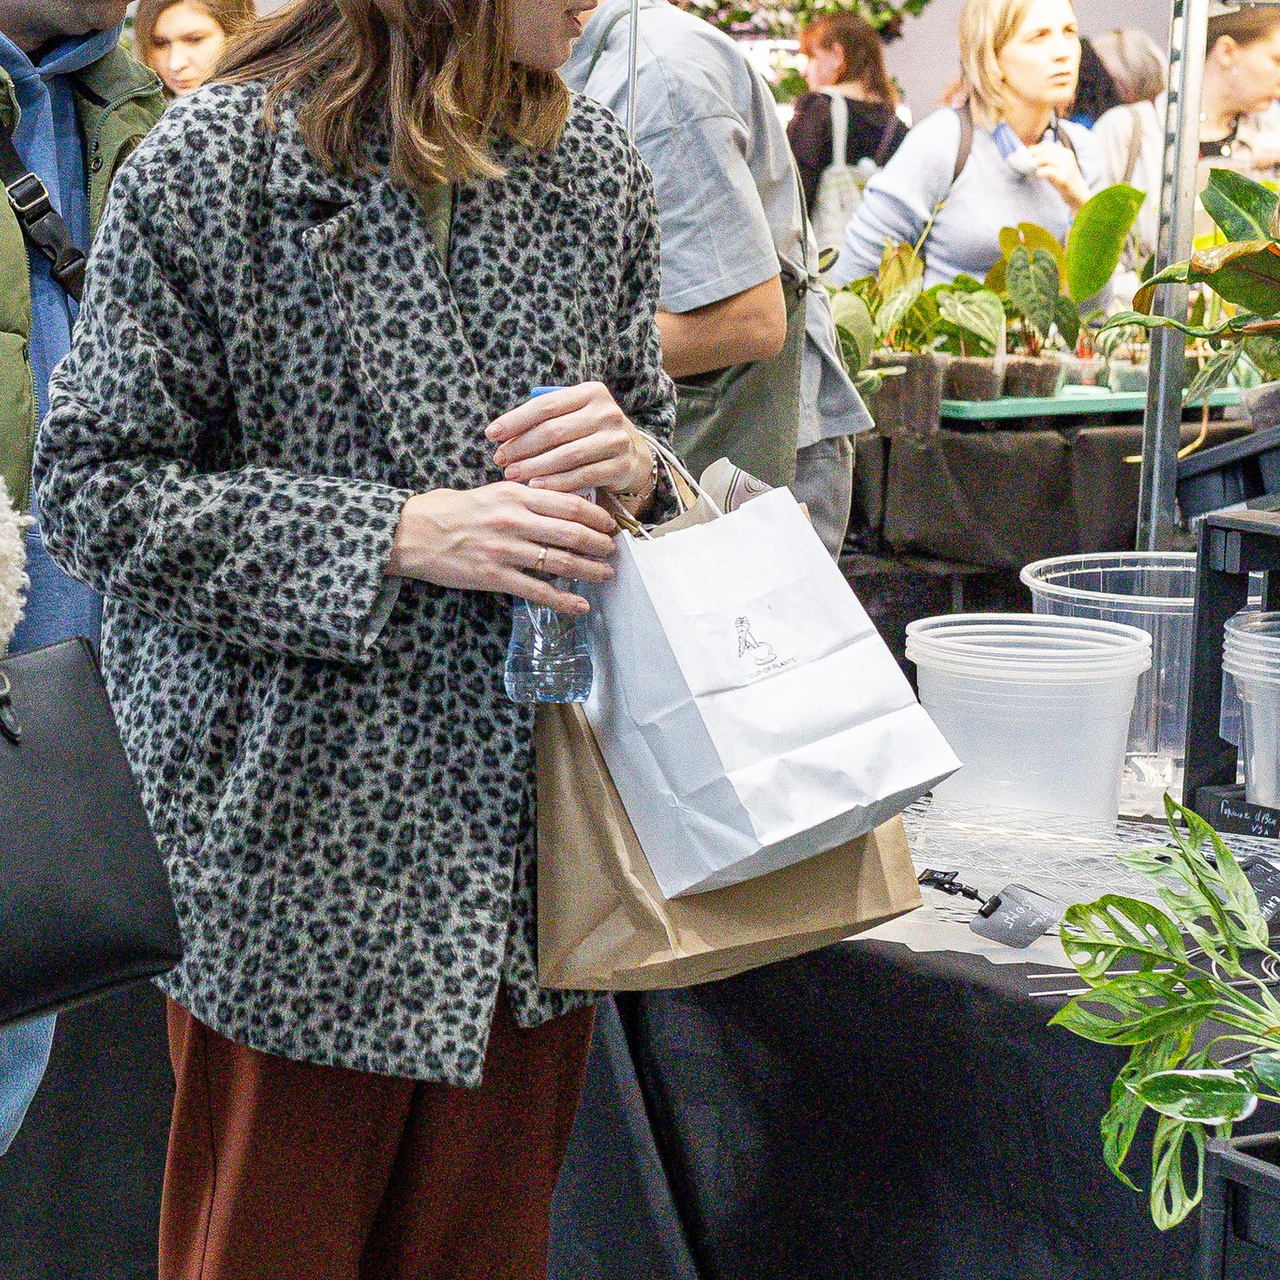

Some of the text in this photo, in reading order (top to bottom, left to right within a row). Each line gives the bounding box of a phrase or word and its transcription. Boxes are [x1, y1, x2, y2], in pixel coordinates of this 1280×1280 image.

[748, 657, 797, 680] CUP OF PLANTS
